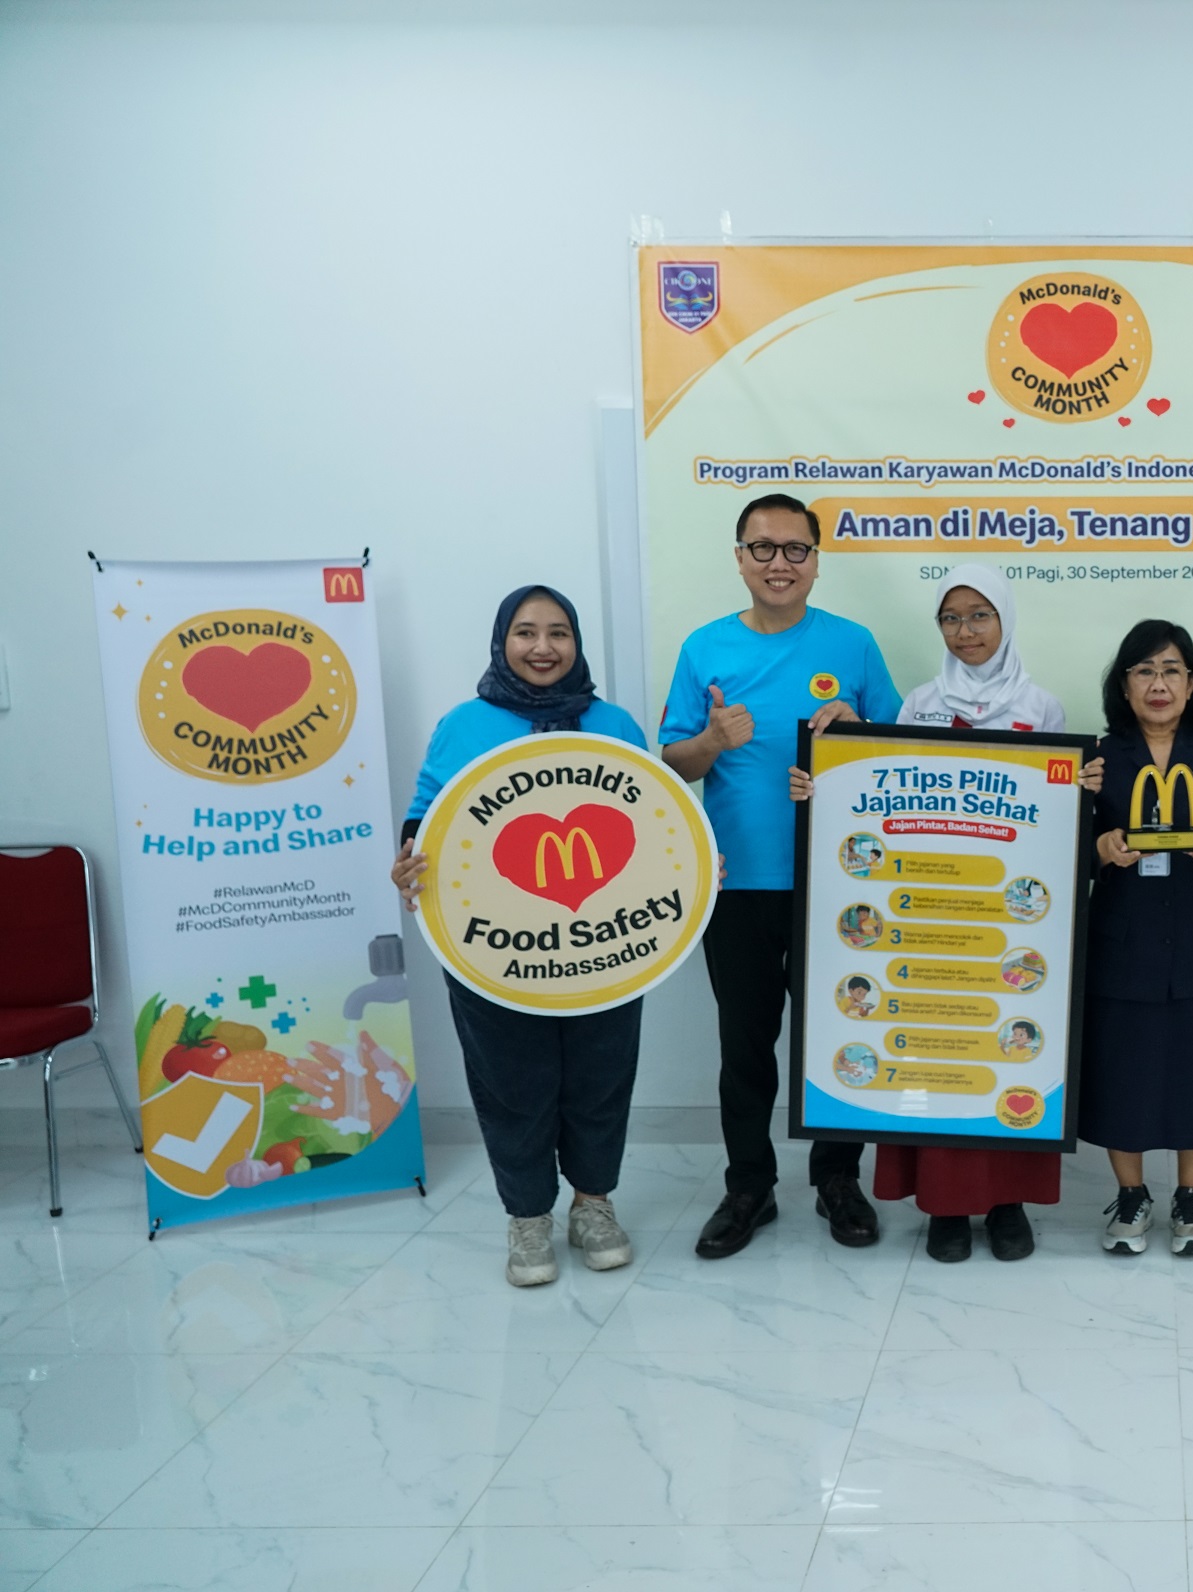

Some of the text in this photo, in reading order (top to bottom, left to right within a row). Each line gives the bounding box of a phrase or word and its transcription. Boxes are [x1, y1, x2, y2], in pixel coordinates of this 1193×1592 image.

[1019, 282, 1122, 305] McDonald's
[1011, 357, 1129, 398] COMMUNITY
[1033, 391, 1110, 415] MONTH
[699, 462, 789, 483] Program
[794, 461, 883, 479] Relawan
[888, 462, 993, 483] Karyawan
[998, 460, 1121, 478] McDonald's
[836, 511, 932, 537] Aman
[940, 510, 970, 537] di
[978, 509, 1065, 544] Meja,
[1070, 511, 1190, 543] Tenang
[1006, 566, 1022, 579] 01
[1027, 566, 1065, 582] Pagi,
[1067, 566, 1087, 579] 30
[1090, 565, 1179, 582] September
[178, 621, 314, 649] McDonald's
[174, 704, 331, 755] COMMUNITY
[207, 746, 308, 776] MONTH
[872, 766, 1018, 796] 7 Tips Pilih
[468, 764, 641, 826] McDonald's
[851, 790, 1039, 823] Jajanan Sehat
[193, 803, 322, 832] Happy to
[889, 820, 1009, 837] Jajan Pintar, Badan Sehat!
[142, 822, 373, 862] Help and Share
[893, 858, 902, 874] 1
[213, 879, 315, 899] #RelawanMcD
[899, 894, 911, 909] 2
[178, 891, 351, 918] #McDCommunityMonth
[175, 905, 356, 932] #FoodSafetyAmbassador
[463, 888, 684, 951] Food Safety
[890, 929, 902, 944] 3
[503, 936, 659, 979] Ambassador
[897, 965, 909, 980] 4
[887, 999, 899, 1014] 5
[894, 1034, 907, 1049] 6
[886, 1068, 897, 1082] 7
